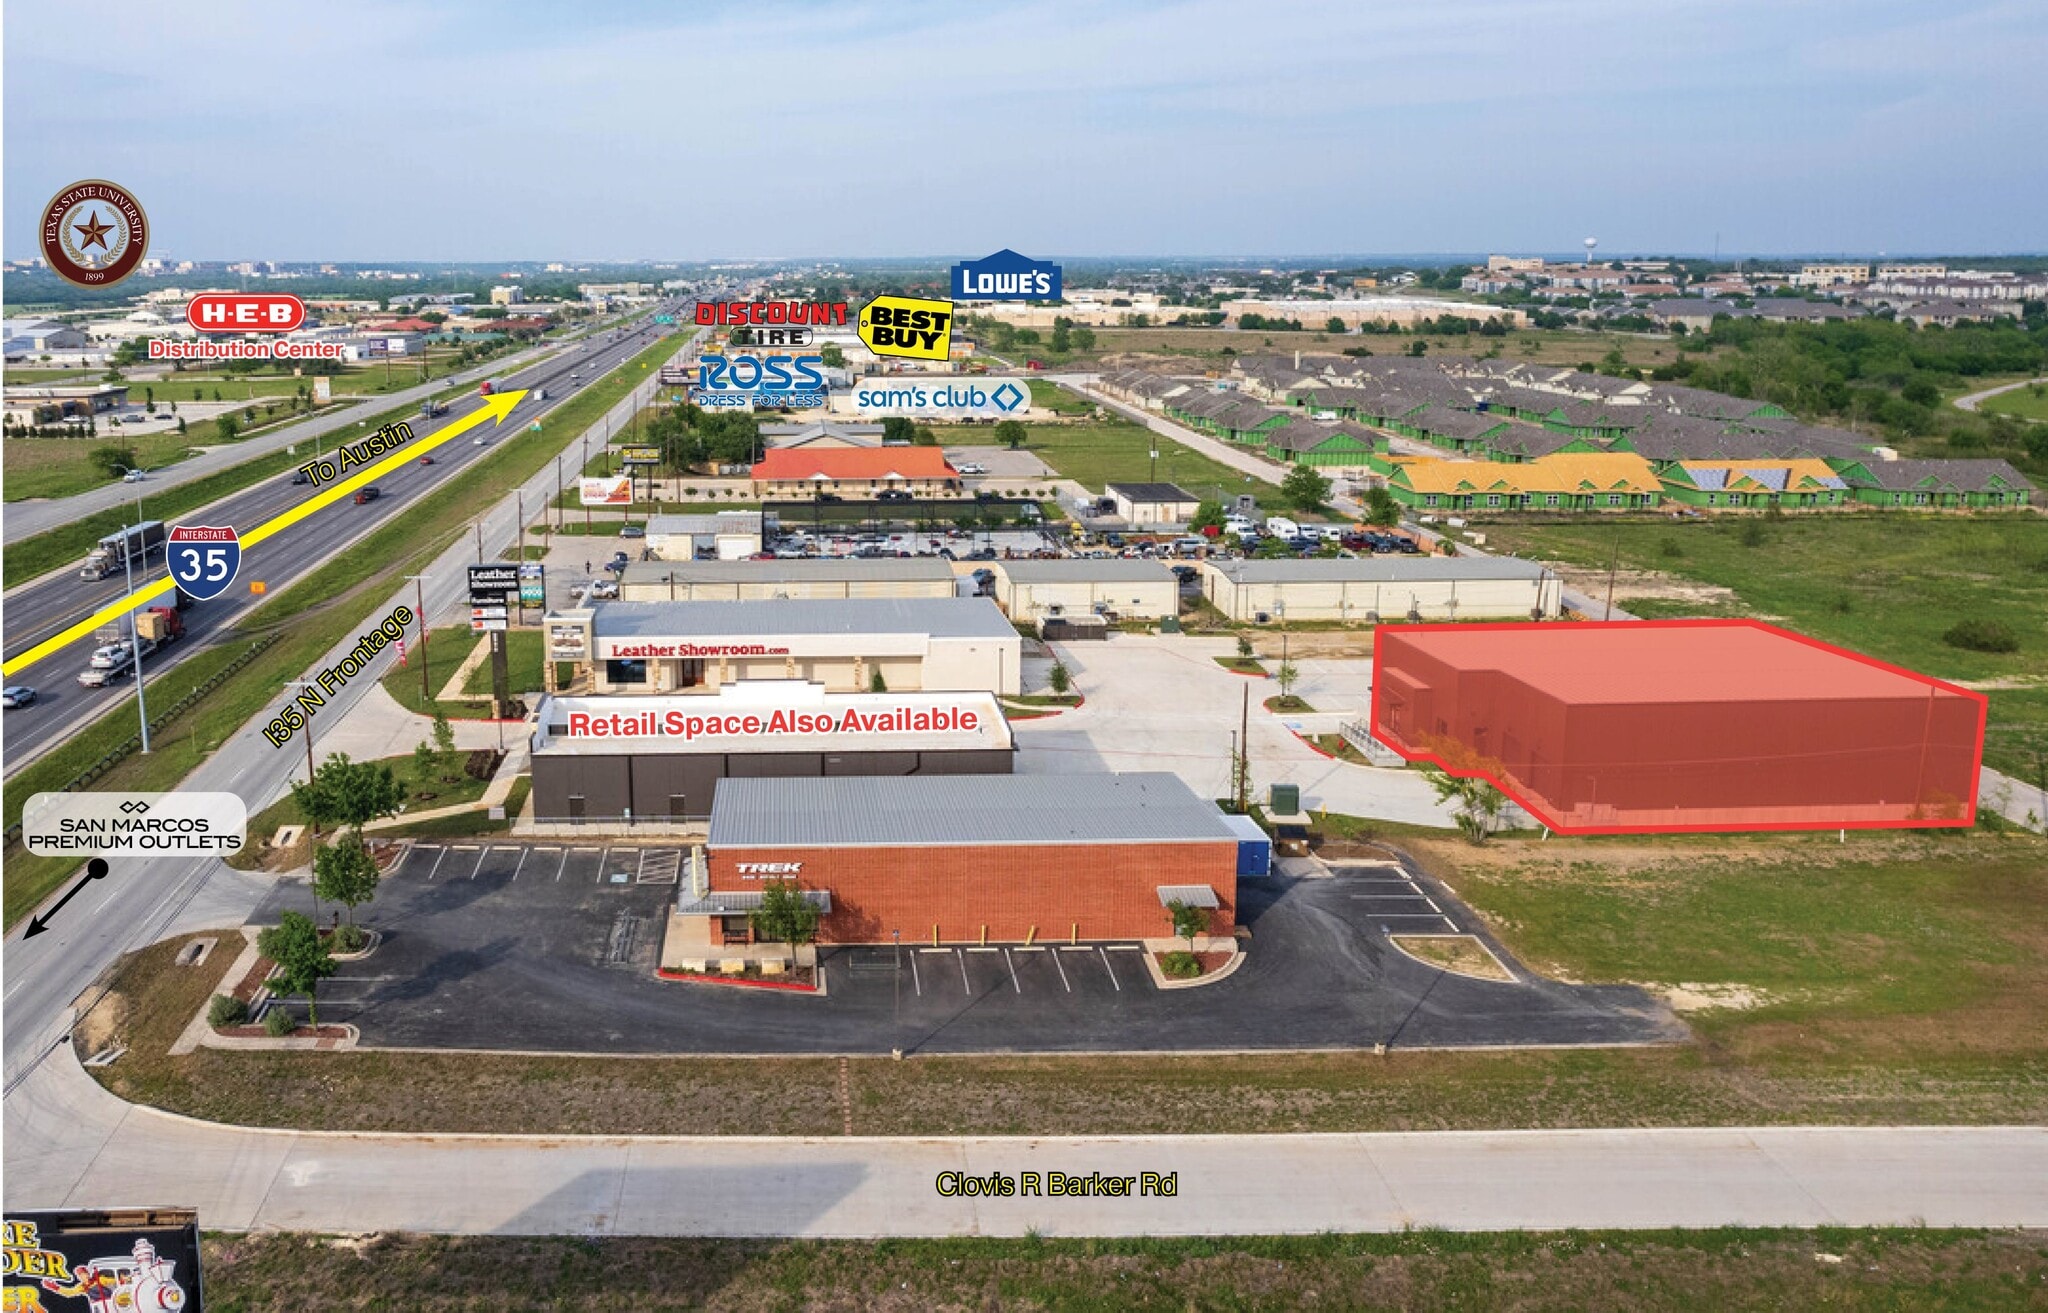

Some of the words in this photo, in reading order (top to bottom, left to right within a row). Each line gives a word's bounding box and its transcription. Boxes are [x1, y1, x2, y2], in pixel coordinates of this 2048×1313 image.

[470, 569, 516, 580] Leather
[612, 644, 676, 657] Leather
[735, 862, 804, 874] TREK
